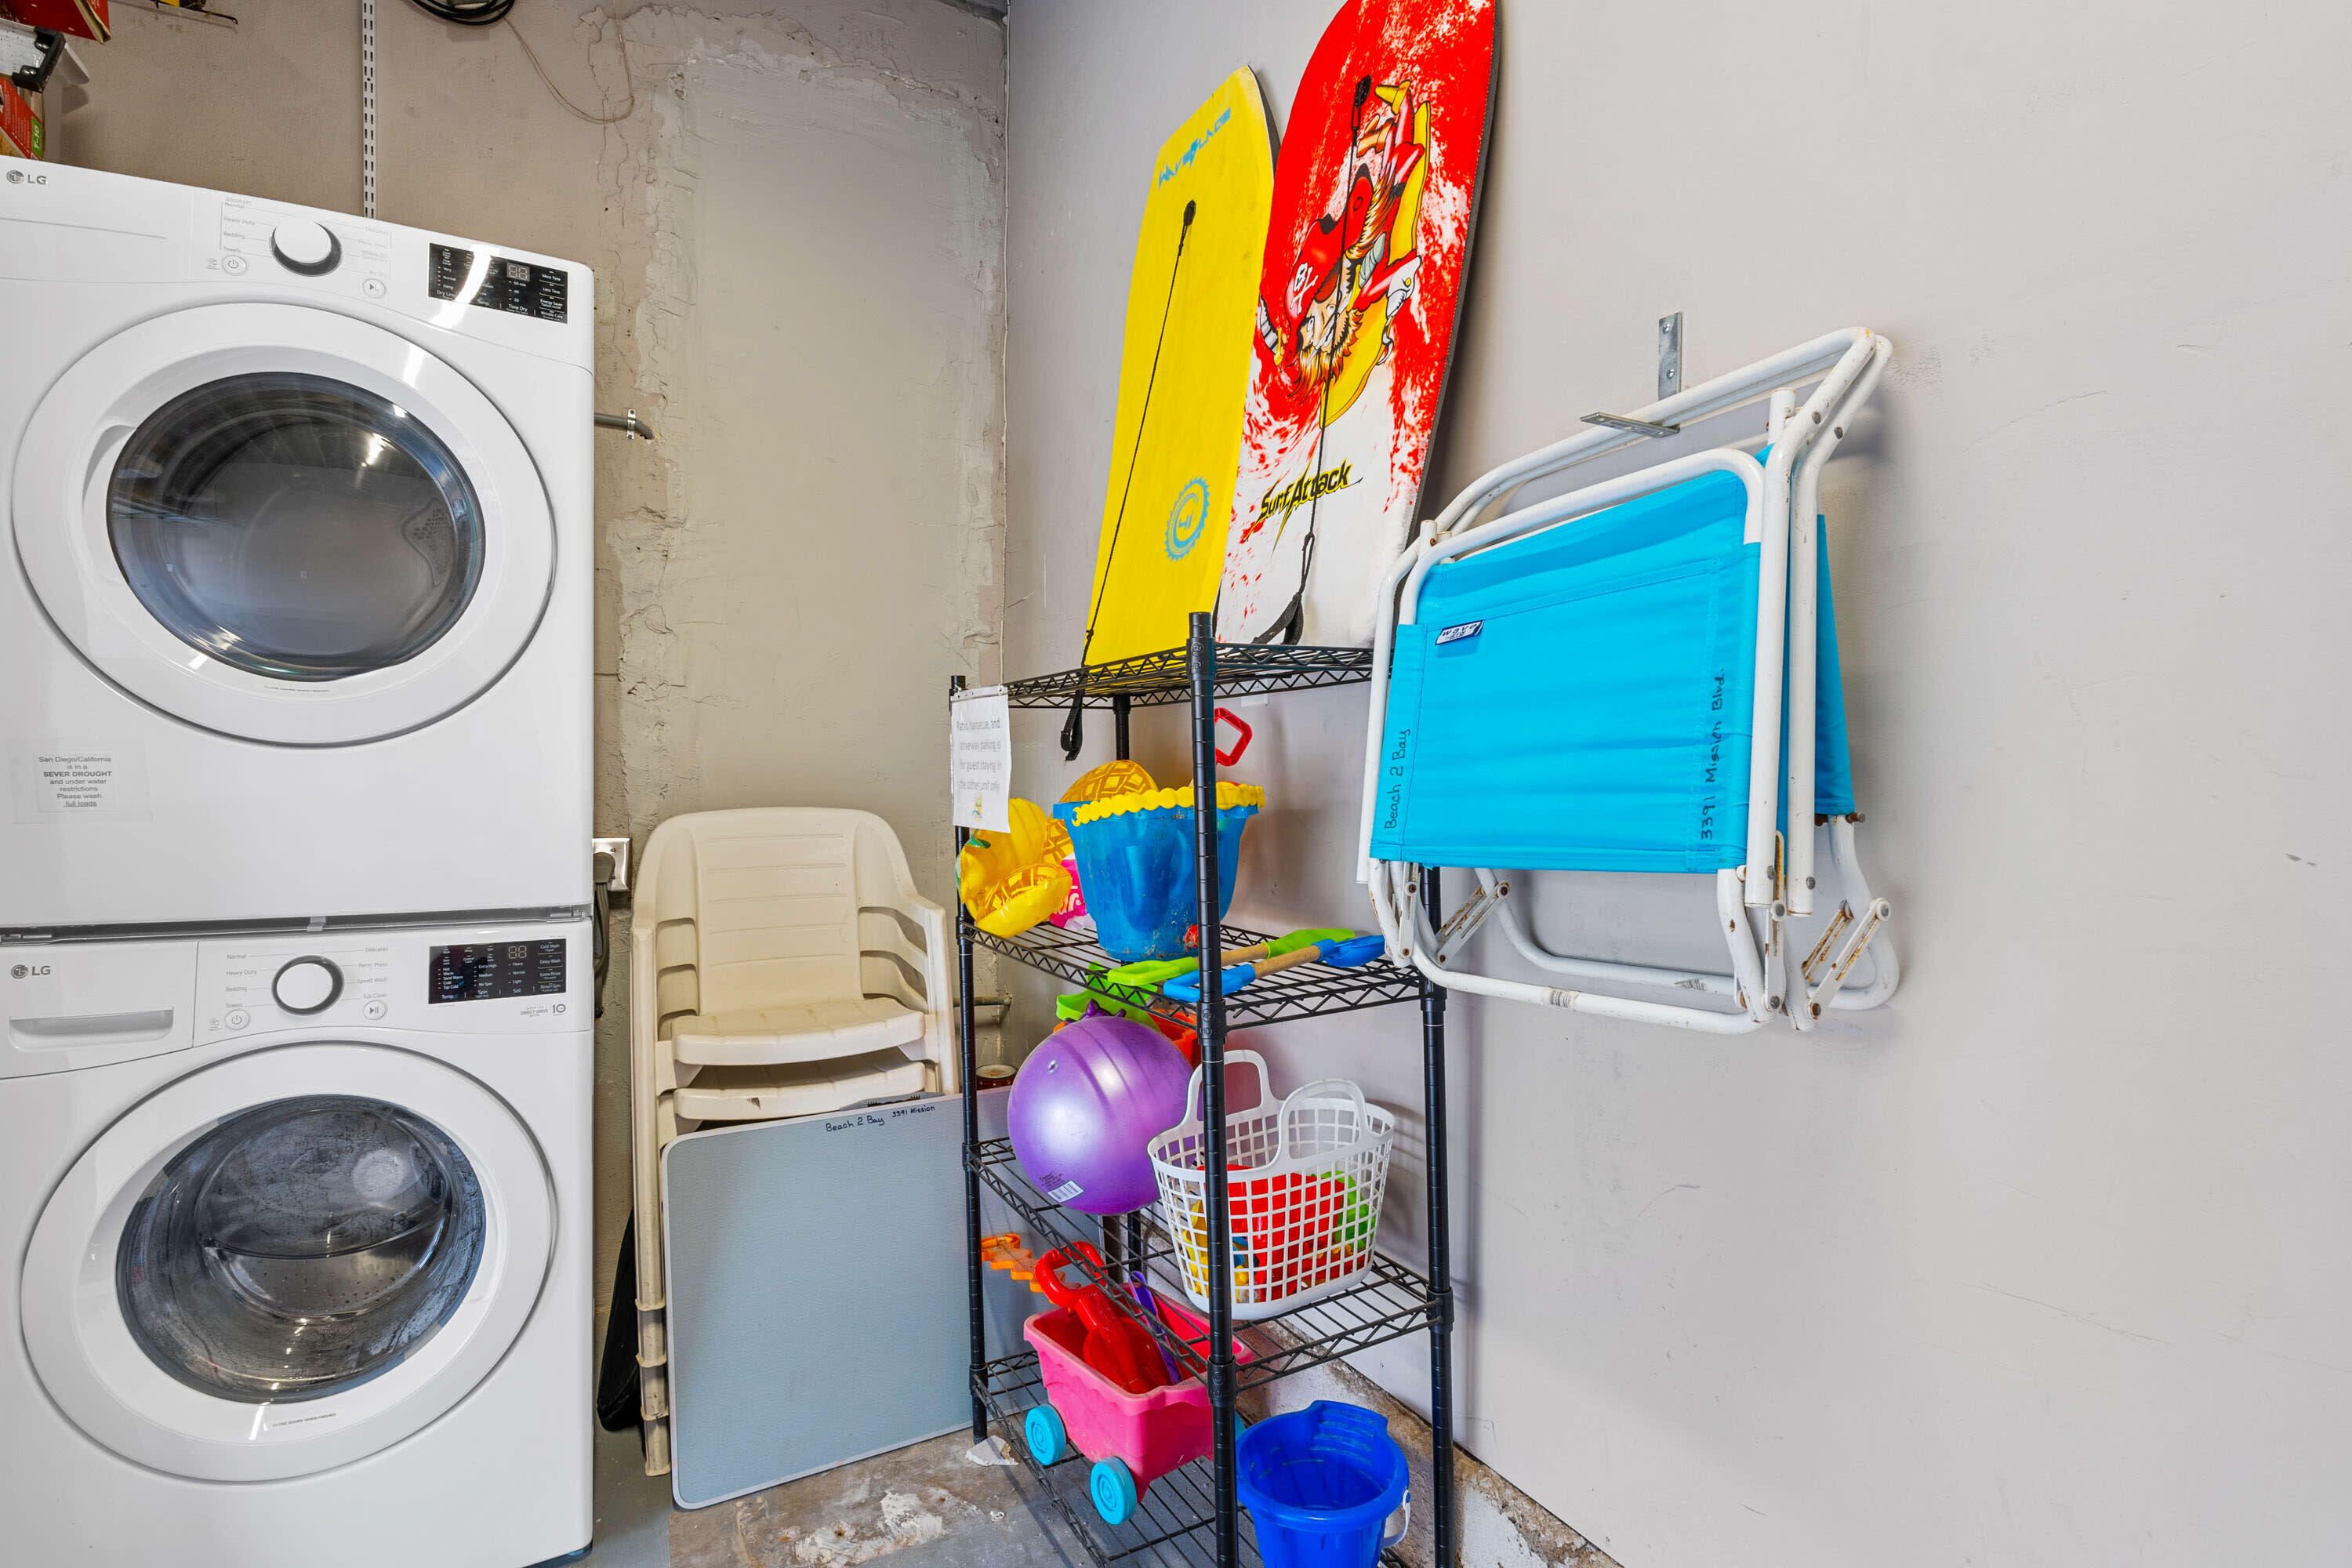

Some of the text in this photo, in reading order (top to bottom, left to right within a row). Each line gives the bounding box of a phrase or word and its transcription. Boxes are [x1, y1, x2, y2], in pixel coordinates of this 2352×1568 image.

[1705, 720, 1722, 783] Mission
[1384, 728, 1410, 829] Beach 2 Bay
[1700, 796, 1716, 841] 3391
[31, 965, 51, 975] LG
[826, 1115, 885, 1132] Beach 2 Bay
[909, 1105, 936, 1114] Mission
